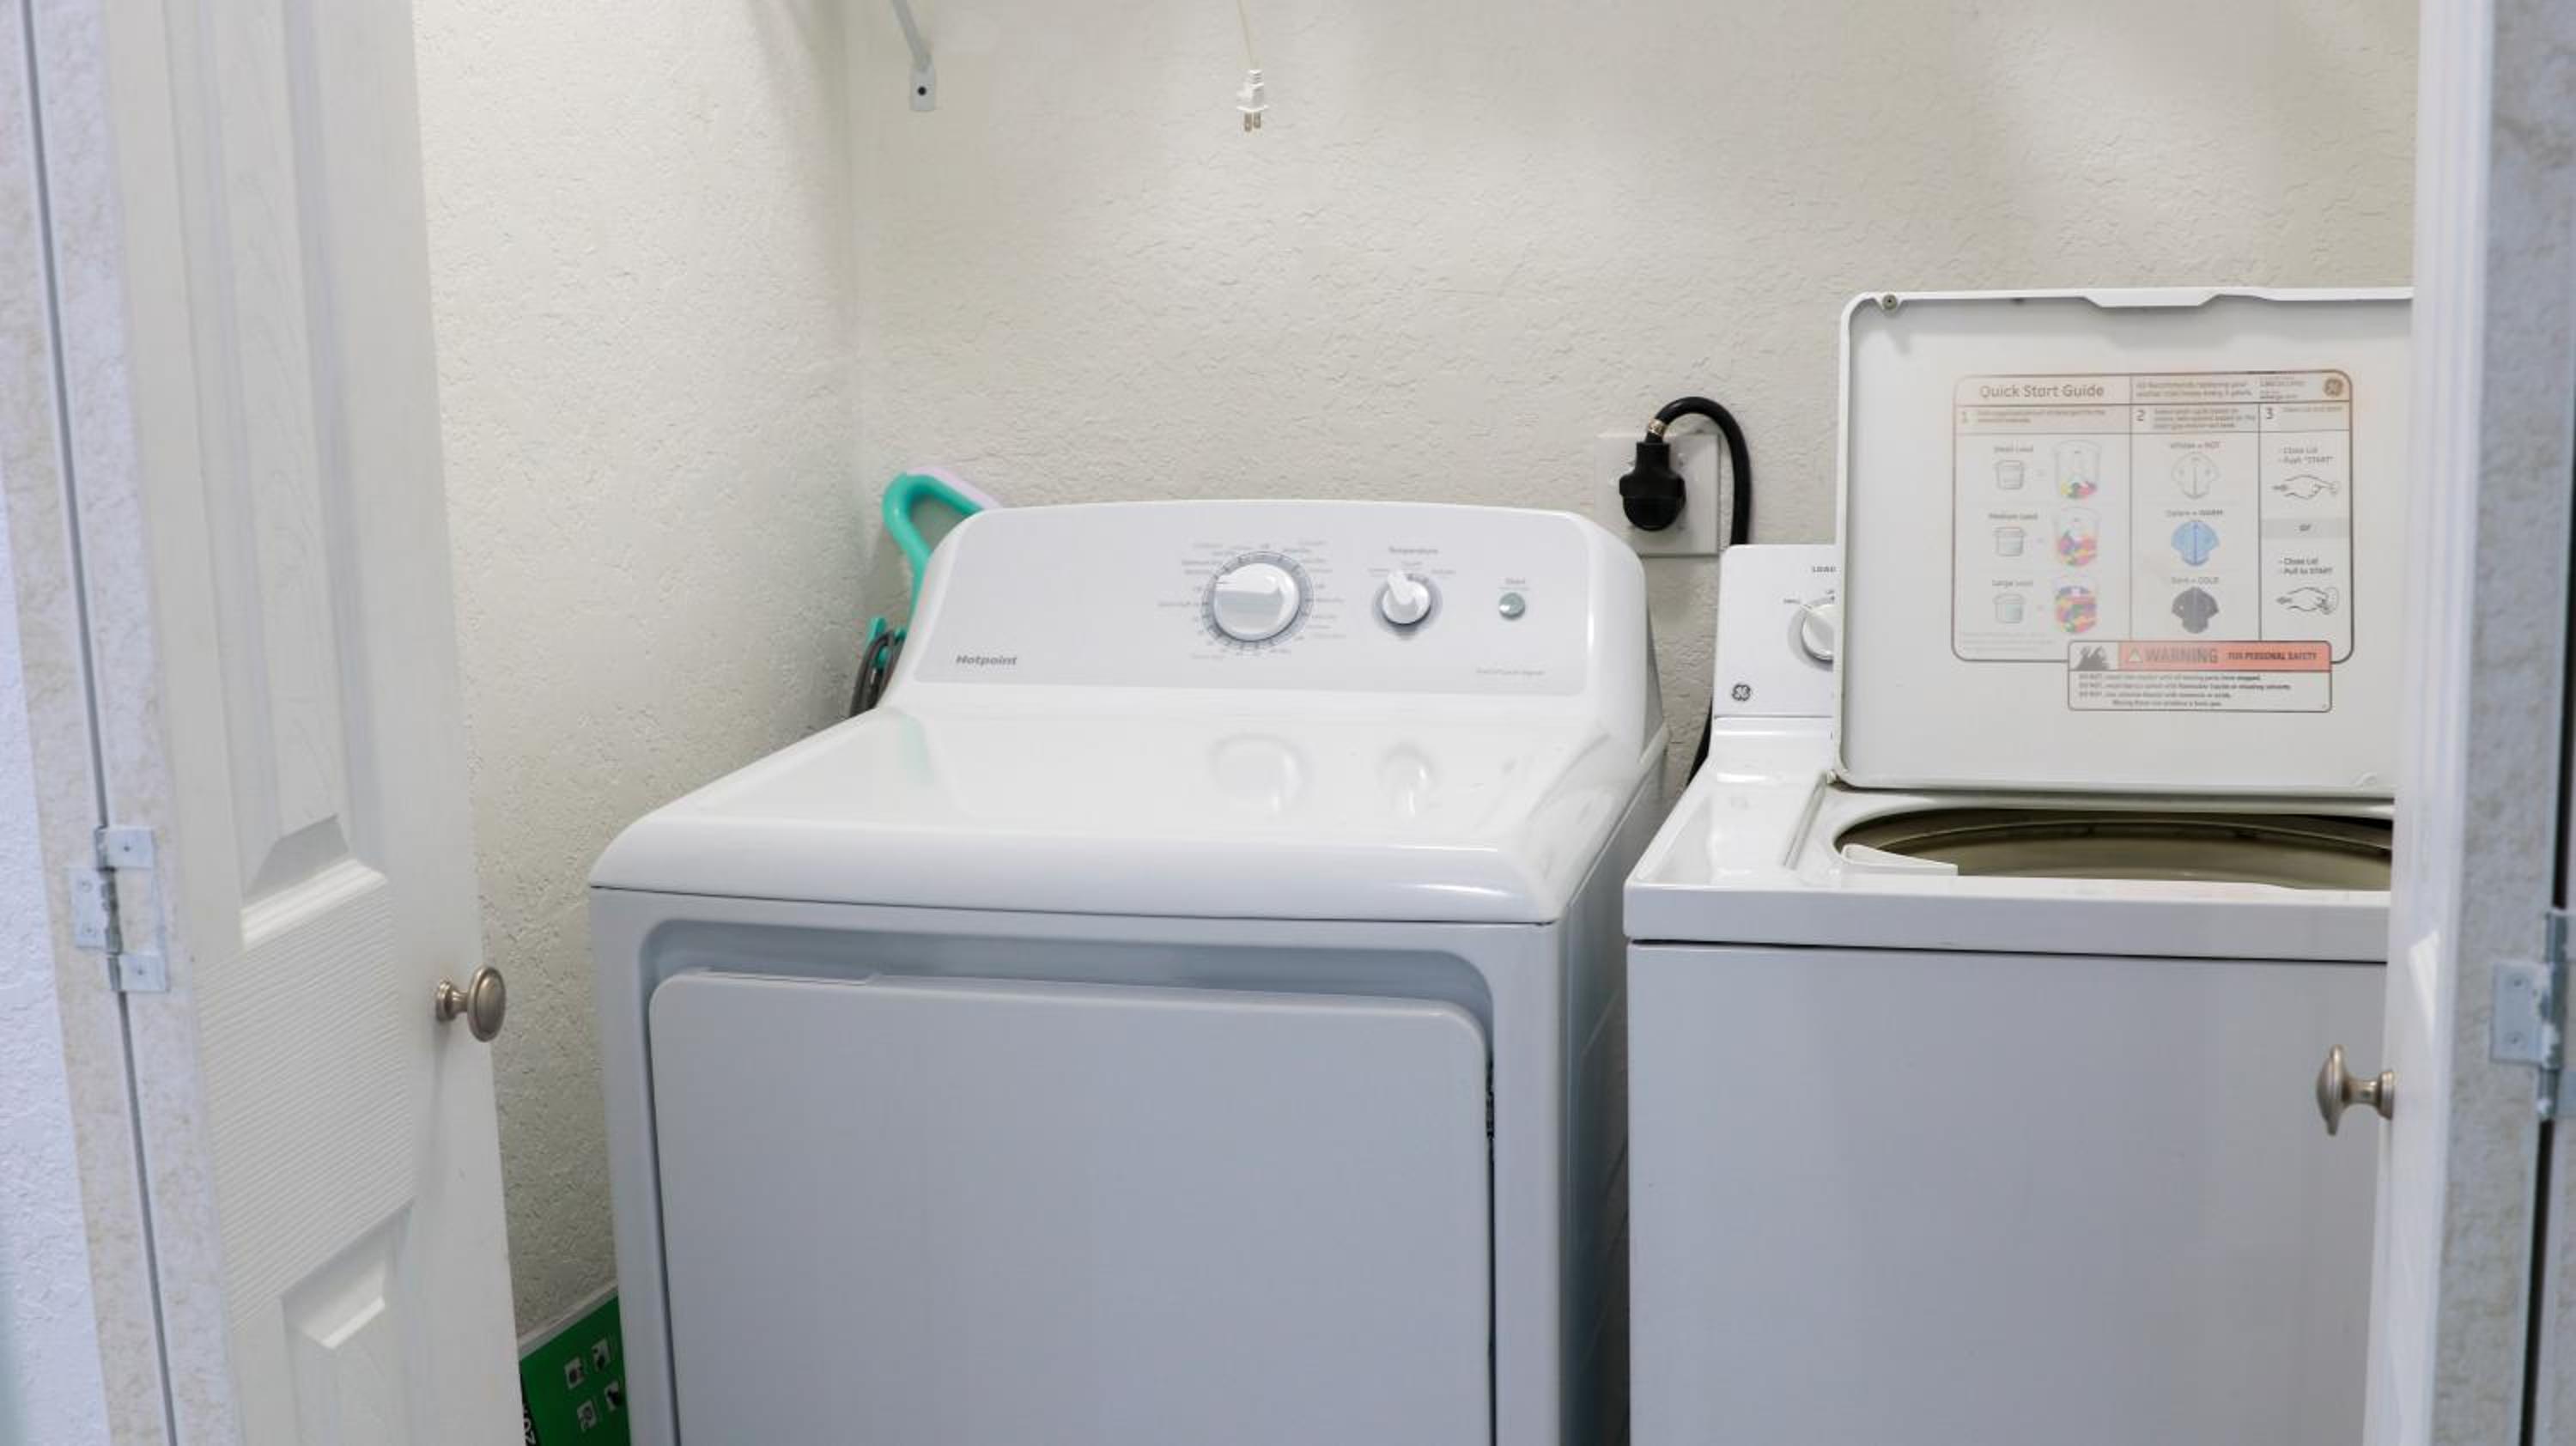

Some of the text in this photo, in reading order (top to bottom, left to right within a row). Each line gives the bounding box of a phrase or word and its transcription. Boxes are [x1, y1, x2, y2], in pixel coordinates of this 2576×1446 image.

[1979, 384, 2105, 398] Quick Start Guide
[2136, 410, 2145, 422] 2
[2266, 407, 2274, 420] 3
[956, 654, 1018, 666] Hotpoint
[2147, 647, 2219, 664] WARNING
[2245, 652, 2286, 660] PERSONAL
[2287, 652, 2317, 660] SAFETY
